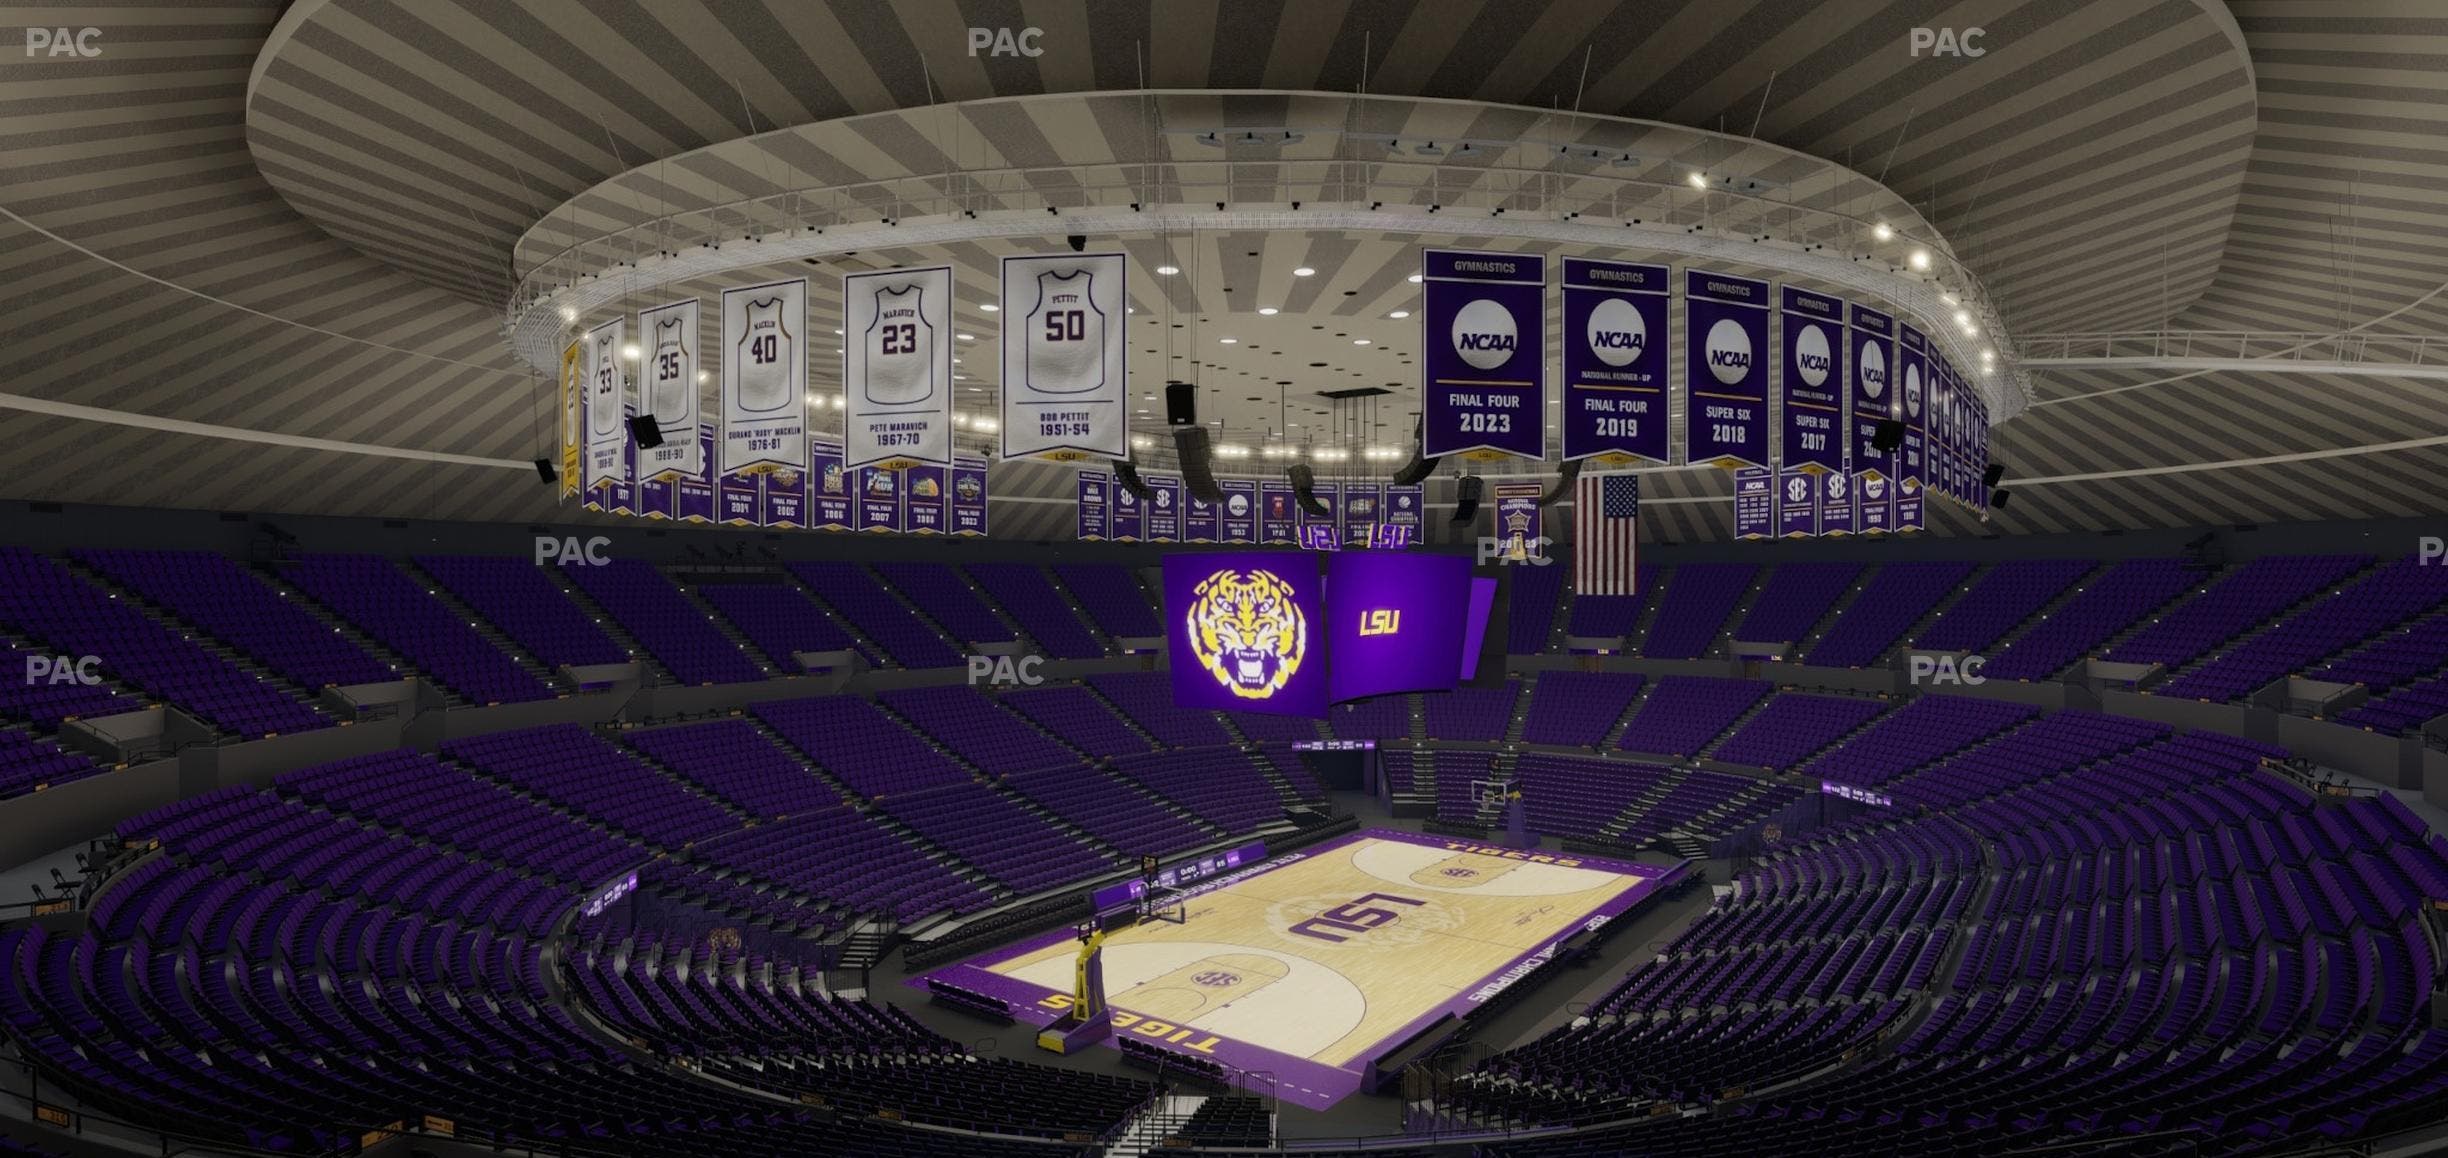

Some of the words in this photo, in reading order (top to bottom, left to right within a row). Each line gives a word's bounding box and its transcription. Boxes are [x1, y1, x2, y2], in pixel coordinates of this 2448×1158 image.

[1454, 260, 1516, 273] GYMNASTICS
[1590, 269, 1644, 283] GYMNASTICS
[1707, 281, 1751, 296] GYMNASTICS
[1052, 294, 1078, 304] PETTIT
[883, 308, 915, 320] MARAVICH
[1046, 310, 1084, 341] 50
[882, 323, 916, 355] 23
[1460, 333, 1516, 351] NCAA
[1594, 331, 1643, 349] NCAA
[752, 334, 776, 364] 40
[659, 352, 679, 380] 35
[1711, 350, 1750, 368] NCAA
[1800, 353, 1829, 371] NCAA
[600, 368, 612, 394] 33
[1581, 371, 1611, 380] NATIONAL
[1864, 367, 1884, 385] NCAA
[1449, 394, 1483, 406] FINAL
[1488, 394, 1520, 408] FOUR
[1585, 398, 1615, 412] FINAL
[1619, 400, 1648, 413] FOUR
[1040, 412, 1057, 421] BOB
[1060, 412, 1089, 421] PETTIT
[1460, 412, 1511, 432] 2023
[1706, 405, 1734, 419] SUPER
[1737, 408, 1751, 421] SIX
[1796, 415, 1818, 427] SUPER
[1819, 418, 1830, 429] SIX
[775, 426, 801, 436] MACKLIN
[870, 423, 887, 432] PETE
[890, 421, 928, 431] MARAVICH
[1040, 423, 1089, 436] 1951-54
[1596, 417, 1637, 437] 2019
[1712, 424, 1746, 443] 2018
[748, 438, 781, 451] 1976-81
[877, 433, 919, 446] 1967-70
[1801, 432, 1826, 451] 2017
[1788, 477, 1807, 502] SEC
[870, 513, 890, 522] 2007
[1360, 609, 1400, 636] LSU
[1445, 842, 1583, 868] TIGERS
[1288, 892, 1427, 943] LSU
[1195, 972, 1238, 987] SEC
[1037, 994, 1222, 1054] TIGES
